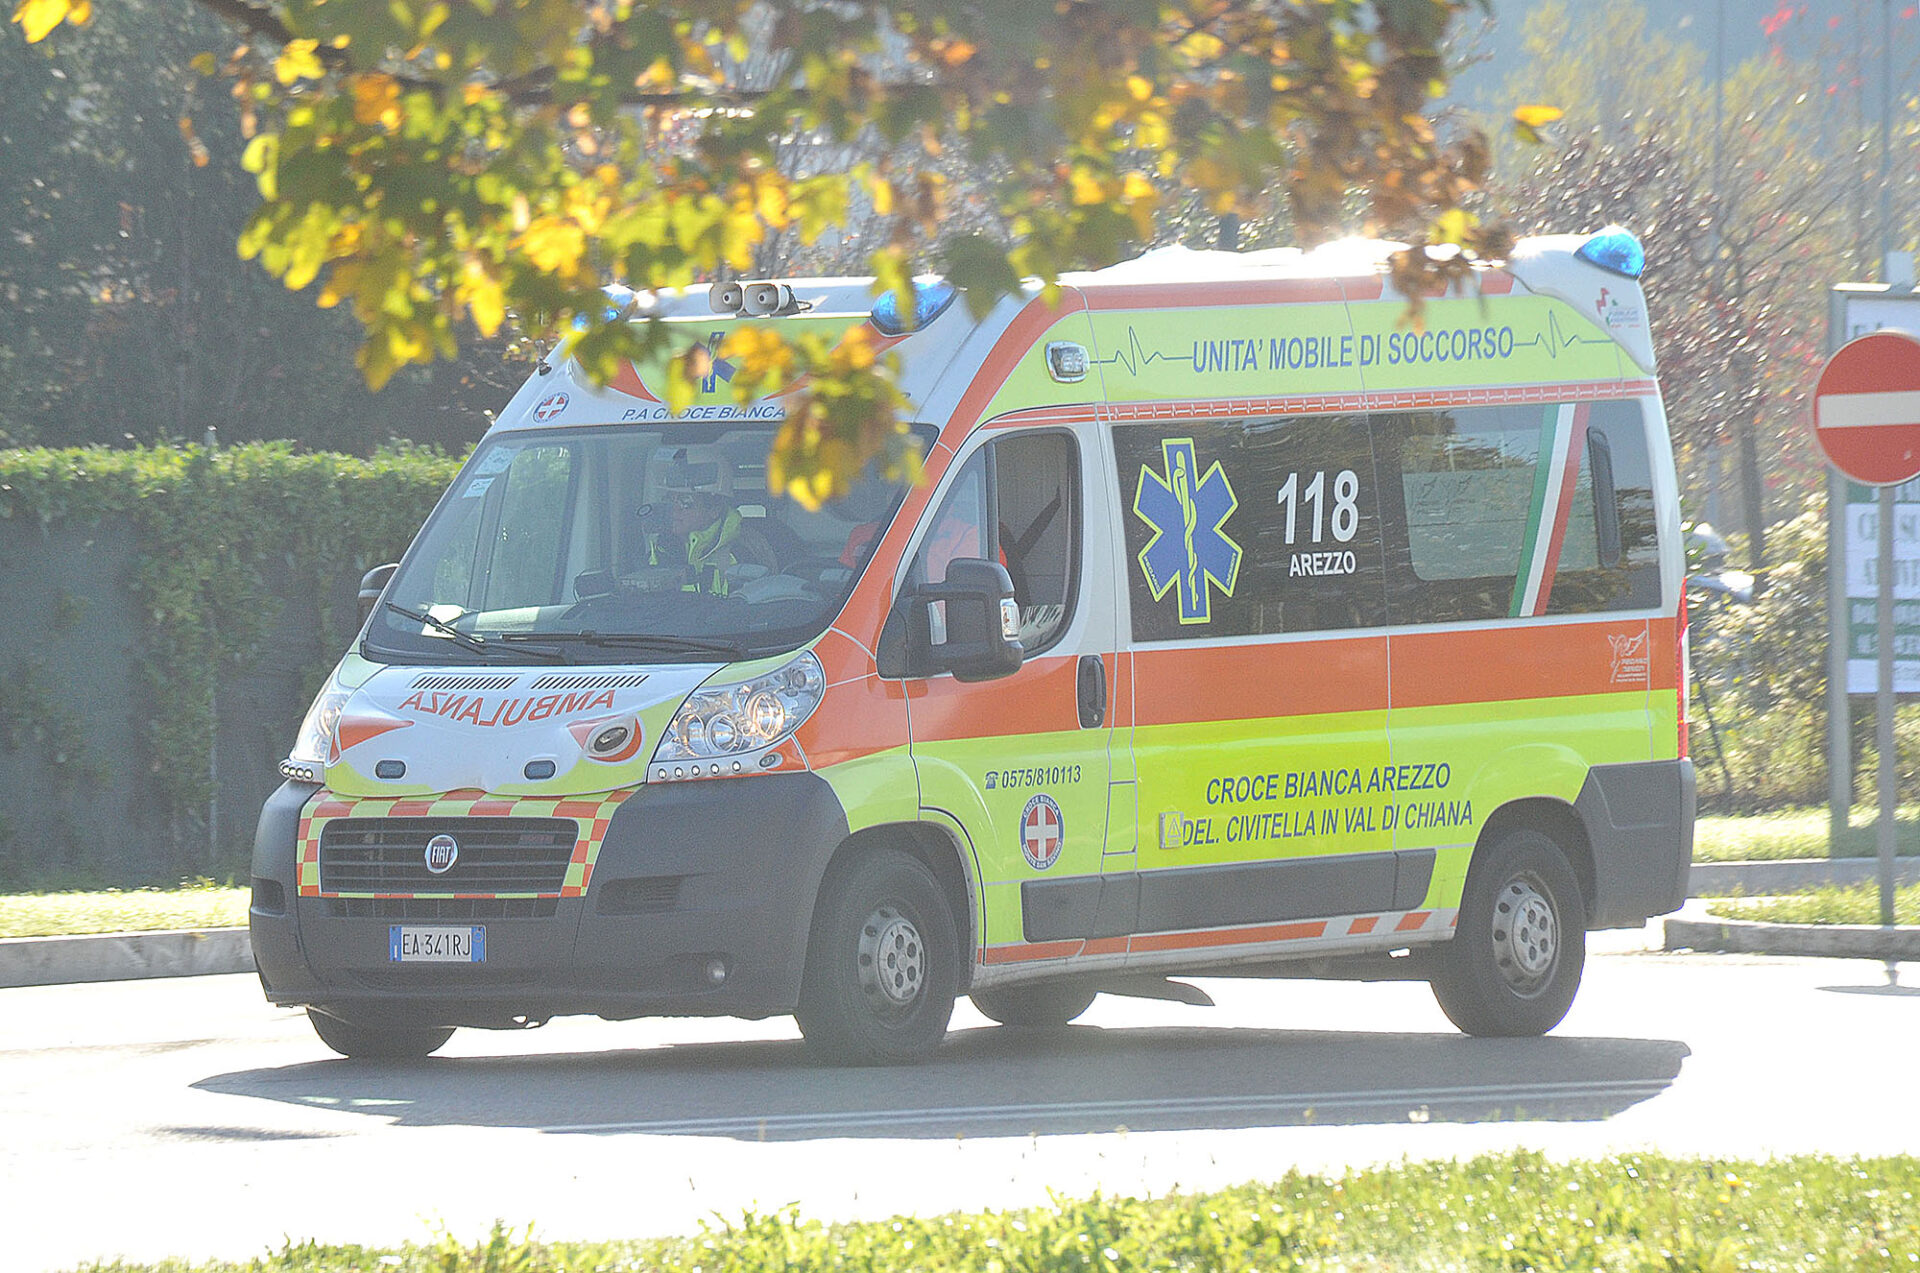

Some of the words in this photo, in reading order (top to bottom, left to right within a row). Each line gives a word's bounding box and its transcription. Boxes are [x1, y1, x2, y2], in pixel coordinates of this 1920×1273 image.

[1269, 335, 1353, 370] MOBILE
[1360, 333, 1381, 366] DI
[1387, 326, 1514, 365] SOCCORSO
[719, 406, 787, 418] BIANCA
[1277, 469, 1359, 545] 118
[1289, 550, 1356, 577] AREZZO
[1001, 764, 1081, 789] 0575/810113
[1207, 773, 1279, 804] CROCE
[1284, 768, 1362, 799] BIANCA
[1366, 762, 1451, 793] AREZZO
[1183, 818, 1220, 847] DEL.
[1226, 809, 1316, 843] CIVITELLA
[1320, 808, 1339, 835] IN
[1344, 804, 1377, 834] VAL
[1381, 804, 1400, 831] DI
[1404, 799, 1473, 829] CHIANA
[431, 846, 452, 864] FIAT
